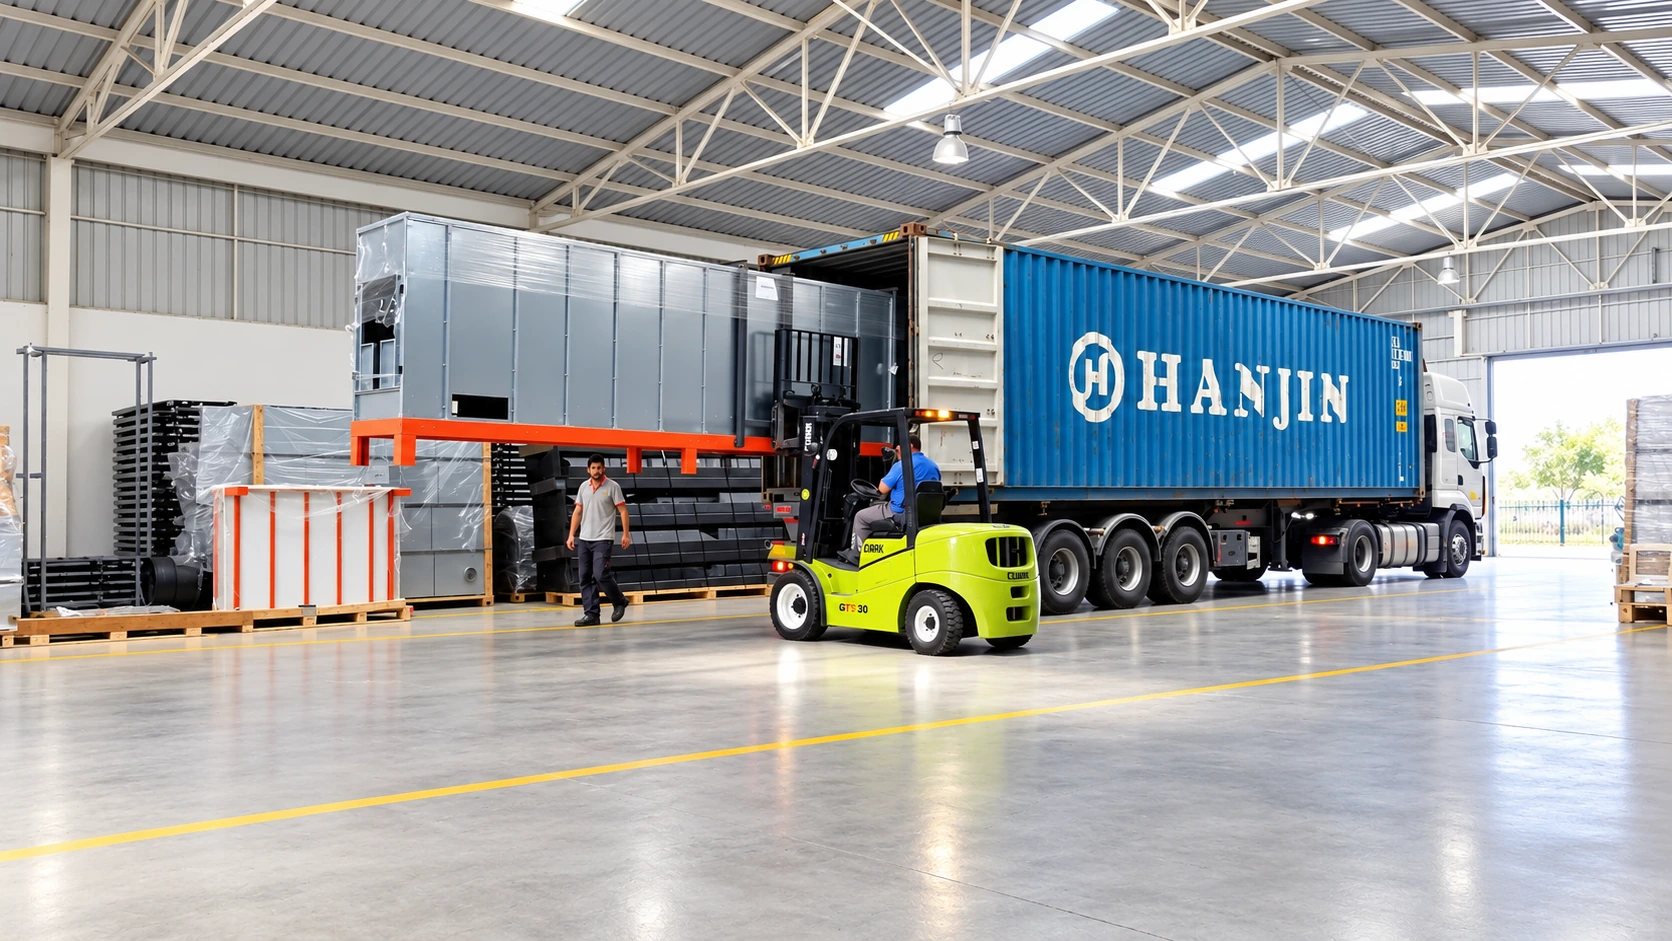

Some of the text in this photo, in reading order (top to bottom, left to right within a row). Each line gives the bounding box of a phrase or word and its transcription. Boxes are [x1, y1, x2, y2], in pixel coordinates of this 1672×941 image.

[1136, 350, 1349, 430] HANJIN
[839, 603, 868, 614] GTS 30
